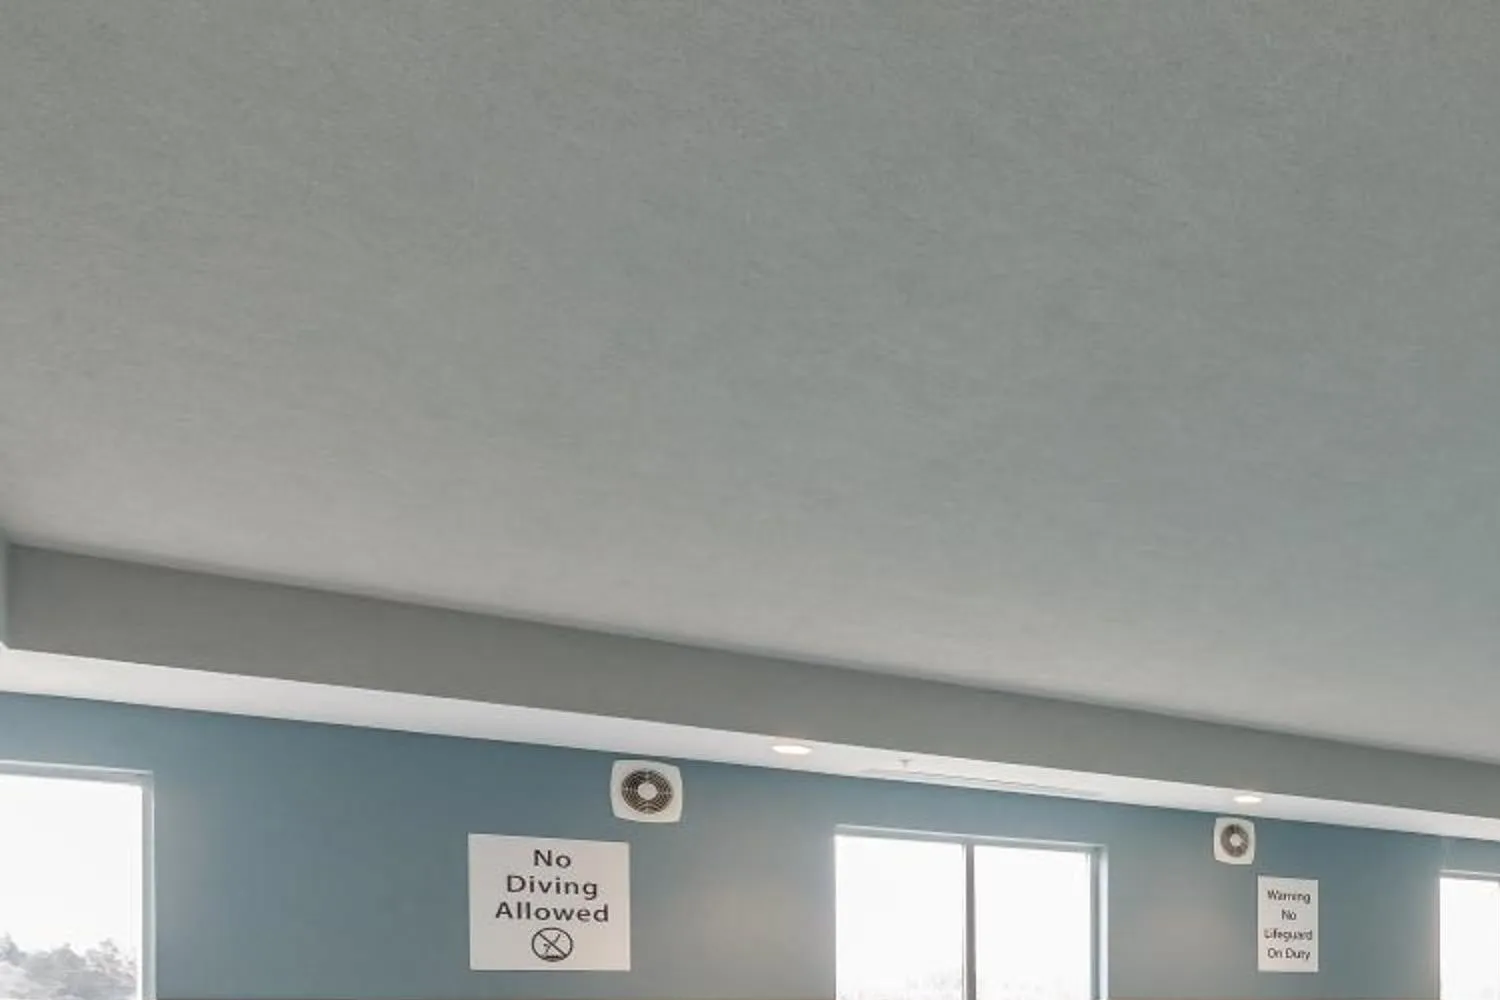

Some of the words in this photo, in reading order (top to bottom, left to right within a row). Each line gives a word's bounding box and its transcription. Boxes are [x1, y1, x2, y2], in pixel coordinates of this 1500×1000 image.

[533, 849, 572, 869] No
[506, 874, 598, 901] Diving
[1267, 889, 1311, 905] Warning
[495, 901, 609, 923] Allowed
[1281, 908, 1297, 921] No
[1263, 928, 1313, 942] Lifeguard
[1267, 947, 1283, 959] On
[1285, 947, 1311, 960] Duty
